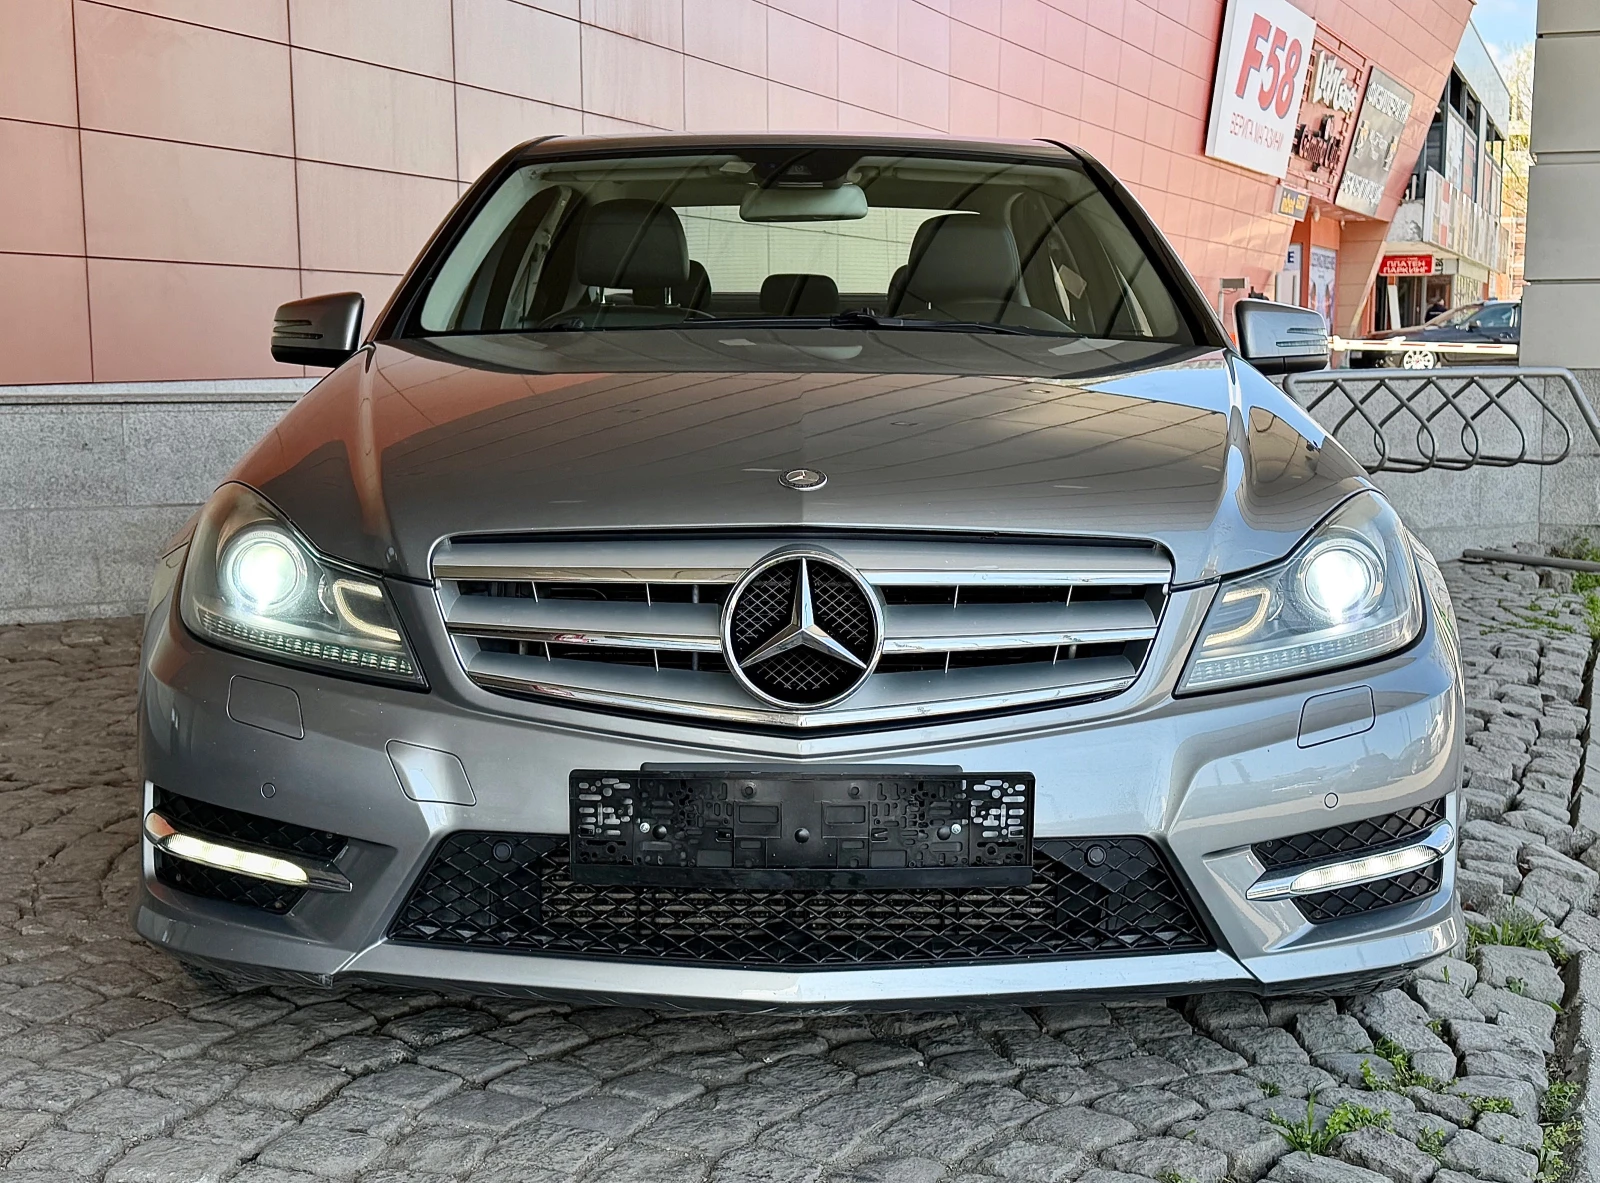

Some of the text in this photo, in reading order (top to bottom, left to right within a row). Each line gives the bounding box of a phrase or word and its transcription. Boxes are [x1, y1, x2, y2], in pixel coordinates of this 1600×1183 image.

[1235, 12, 1302, 119] F58
[1386, 260, 1426, 268] ПЛАТЕН
[1383, 266, 1429, 274] ПАРКИНГ
